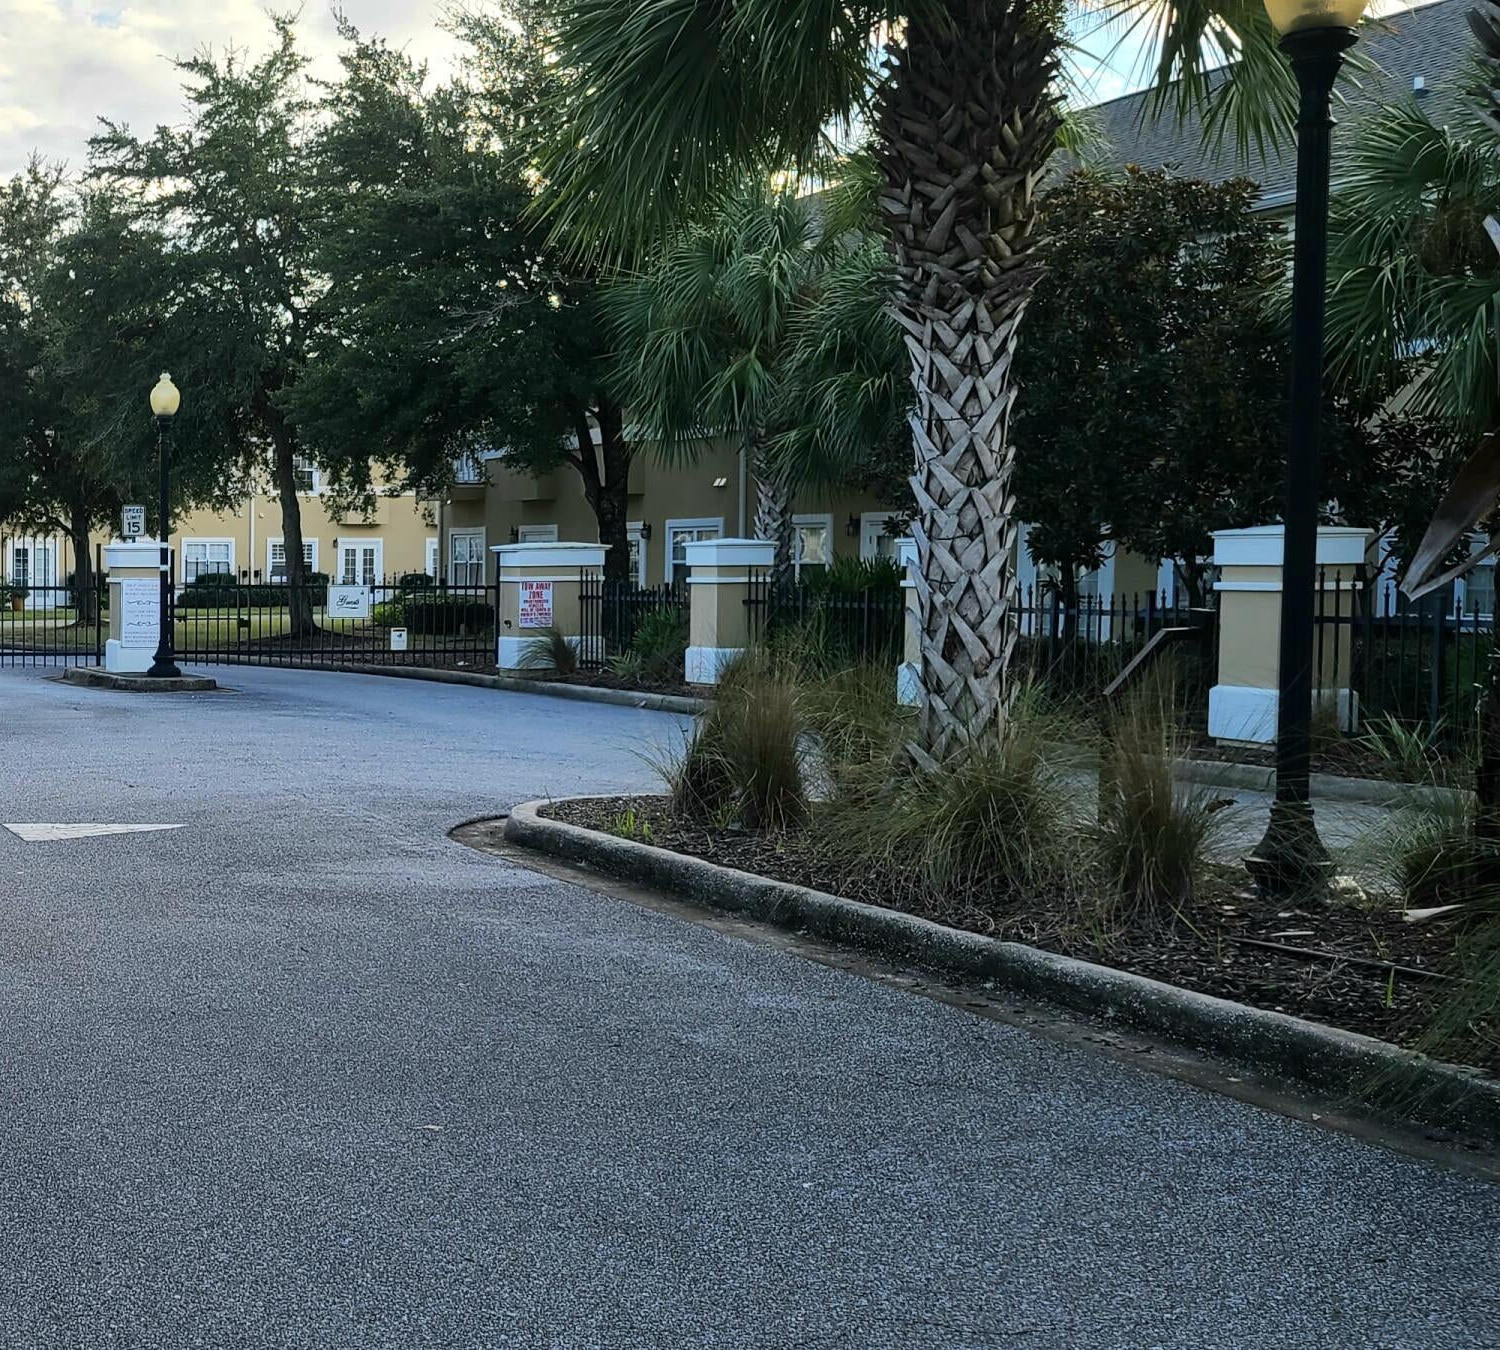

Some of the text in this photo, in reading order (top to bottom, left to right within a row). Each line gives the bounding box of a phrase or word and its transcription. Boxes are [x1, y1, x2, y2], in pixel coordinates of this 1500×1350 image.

[127, 521, 140, 533] 15
[521, 582, 551, 591] TOW AWAY
[528, 591, 544, 599] ZONE
